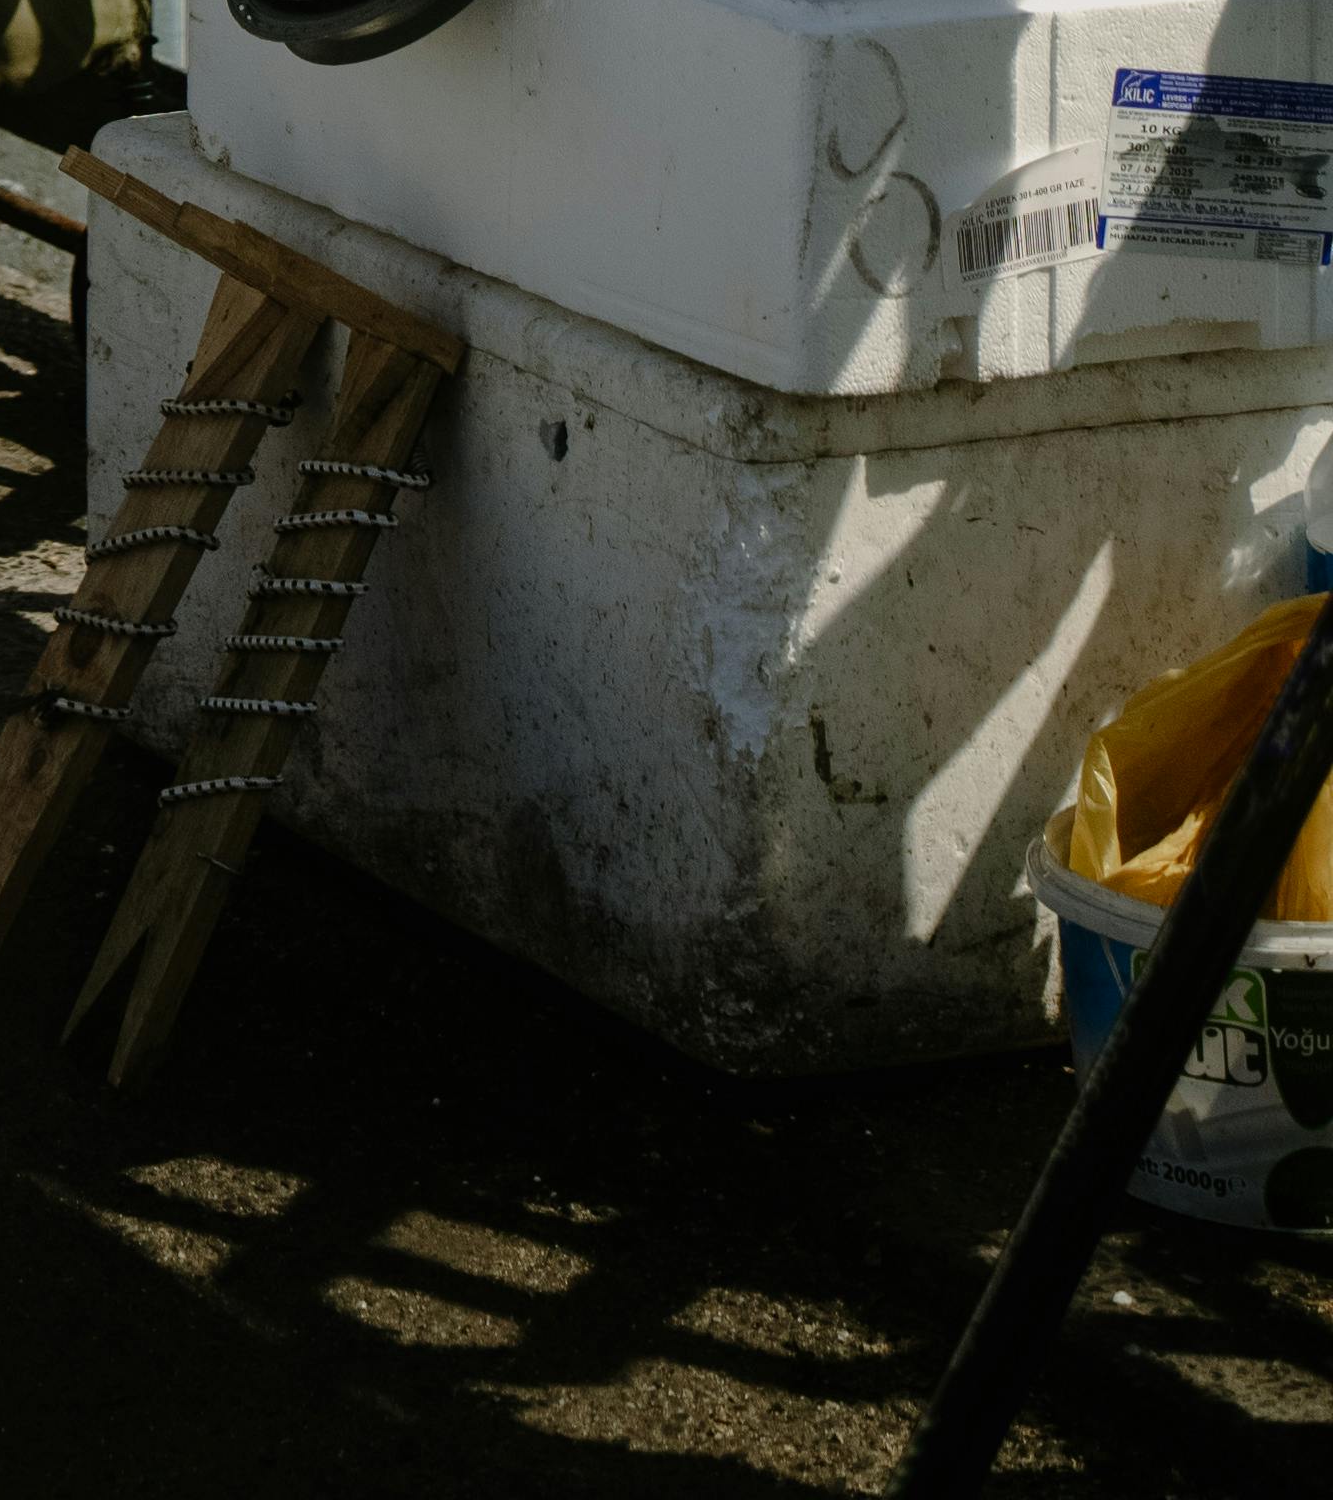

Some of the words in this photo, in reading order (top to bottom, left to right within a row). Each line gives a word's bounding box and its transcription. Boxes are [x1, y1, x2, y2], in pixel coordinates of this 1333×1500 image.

[1141, 124, 1158, 134] 10
[1162, 126, 1182, 137] KG
[1120, 164, 1132, 172] 07
[1169, 167, 1194, 178] 2025
[985, 195, 1017, 209] LEVREK
[1050, 183, 1062, 193] GR
[1065, 178, 1085, 191] TAZE
[986, 209, 996, 219] 10
[997, 206, 1009, 216] KG
[1162, 1162, 1226, 1198] 2000g
